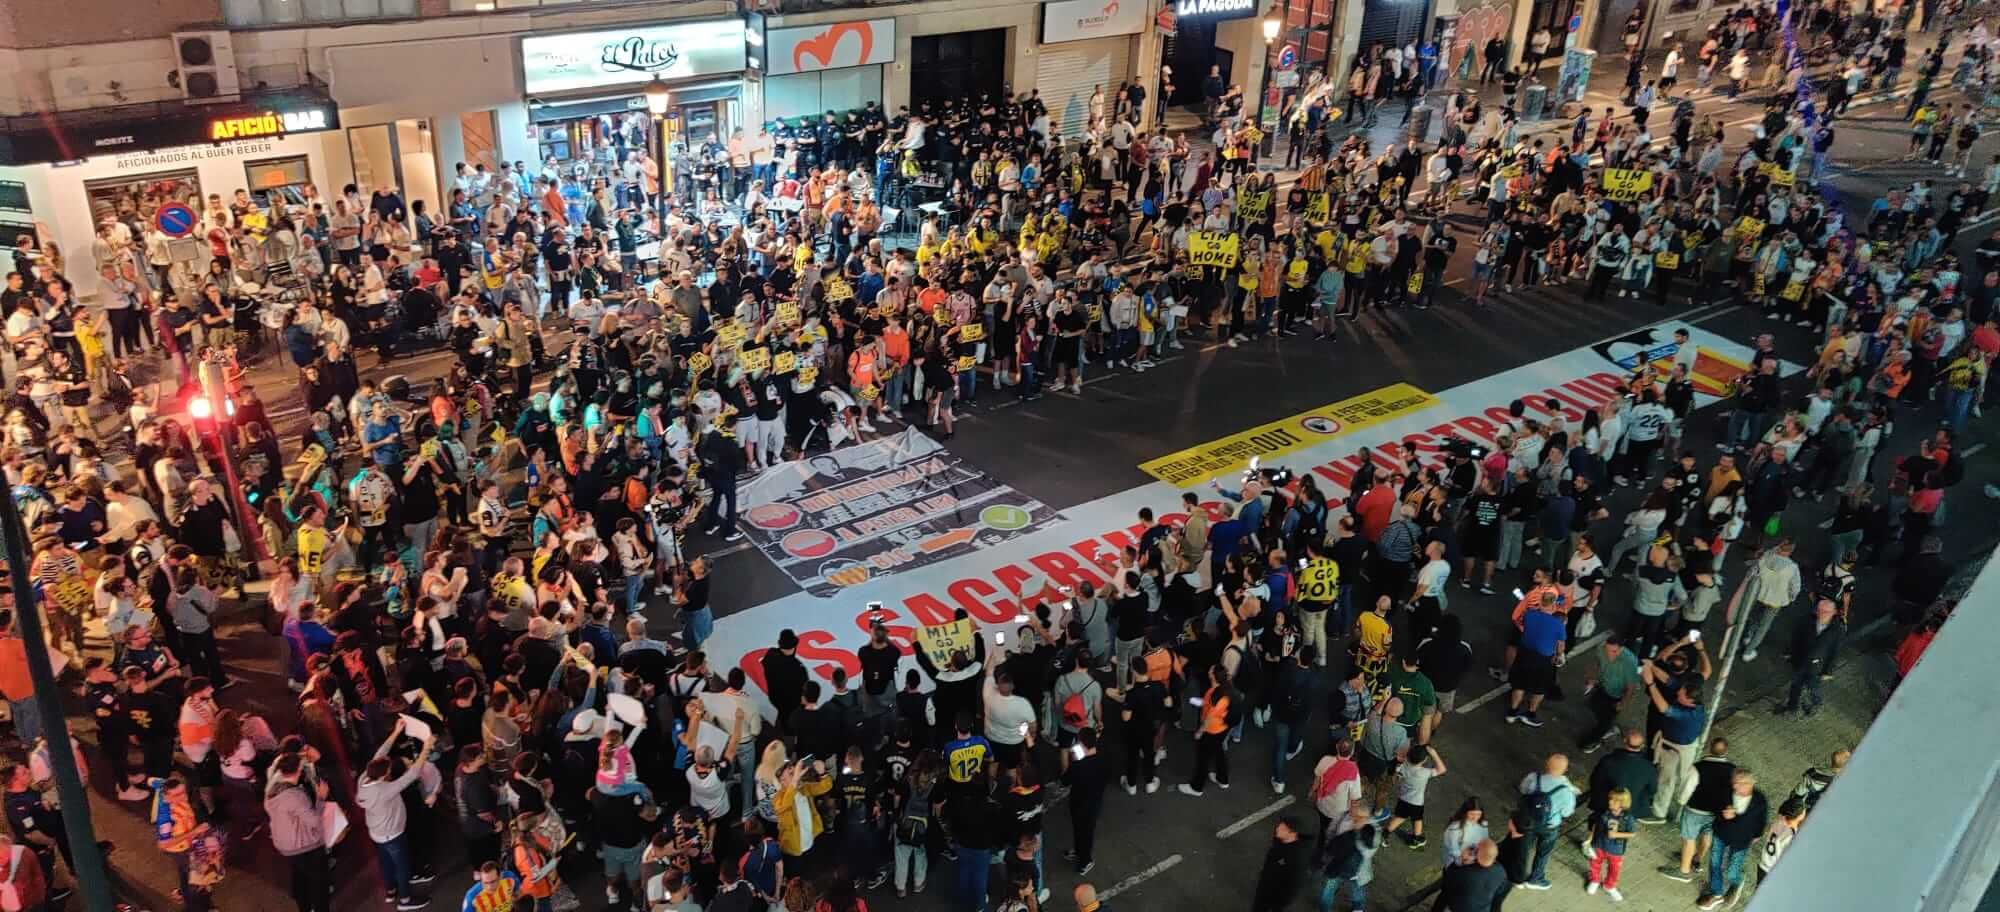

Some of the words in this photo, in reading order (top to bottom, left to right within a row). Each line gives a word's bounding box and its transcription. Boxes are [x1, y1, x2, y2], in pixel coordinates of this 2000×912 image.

[1179, 0, 1198, 16] LA
[1199, 0, 1253, 14] PAGODA
[212, 111, 278, 139] AFICIÓ
[285, 110, 326, 131] BAR
[117, 152, 188, 169] AFICIONADOS
[190, 150, 204, 160] AL
[206, 148, 234, 159] BUEN
[237, 144, 272, 155] BEBER
[1614, 171, 1643, 182] LIM
[1303, 210, 1327, 222] OME
[1200, 231, 1231, 242] LIM
[1193, 251, 1233, 265] HOME
[1640, 414, 1661, 428] 22
[1250, 428, 1302, 451] OUT
[856, 500, 1225, 658] SACARE
[1314, 567, 1332, 581] GO
[1297, 582, 1339, 598] HOM
[958, 757, 980, 779] 12
